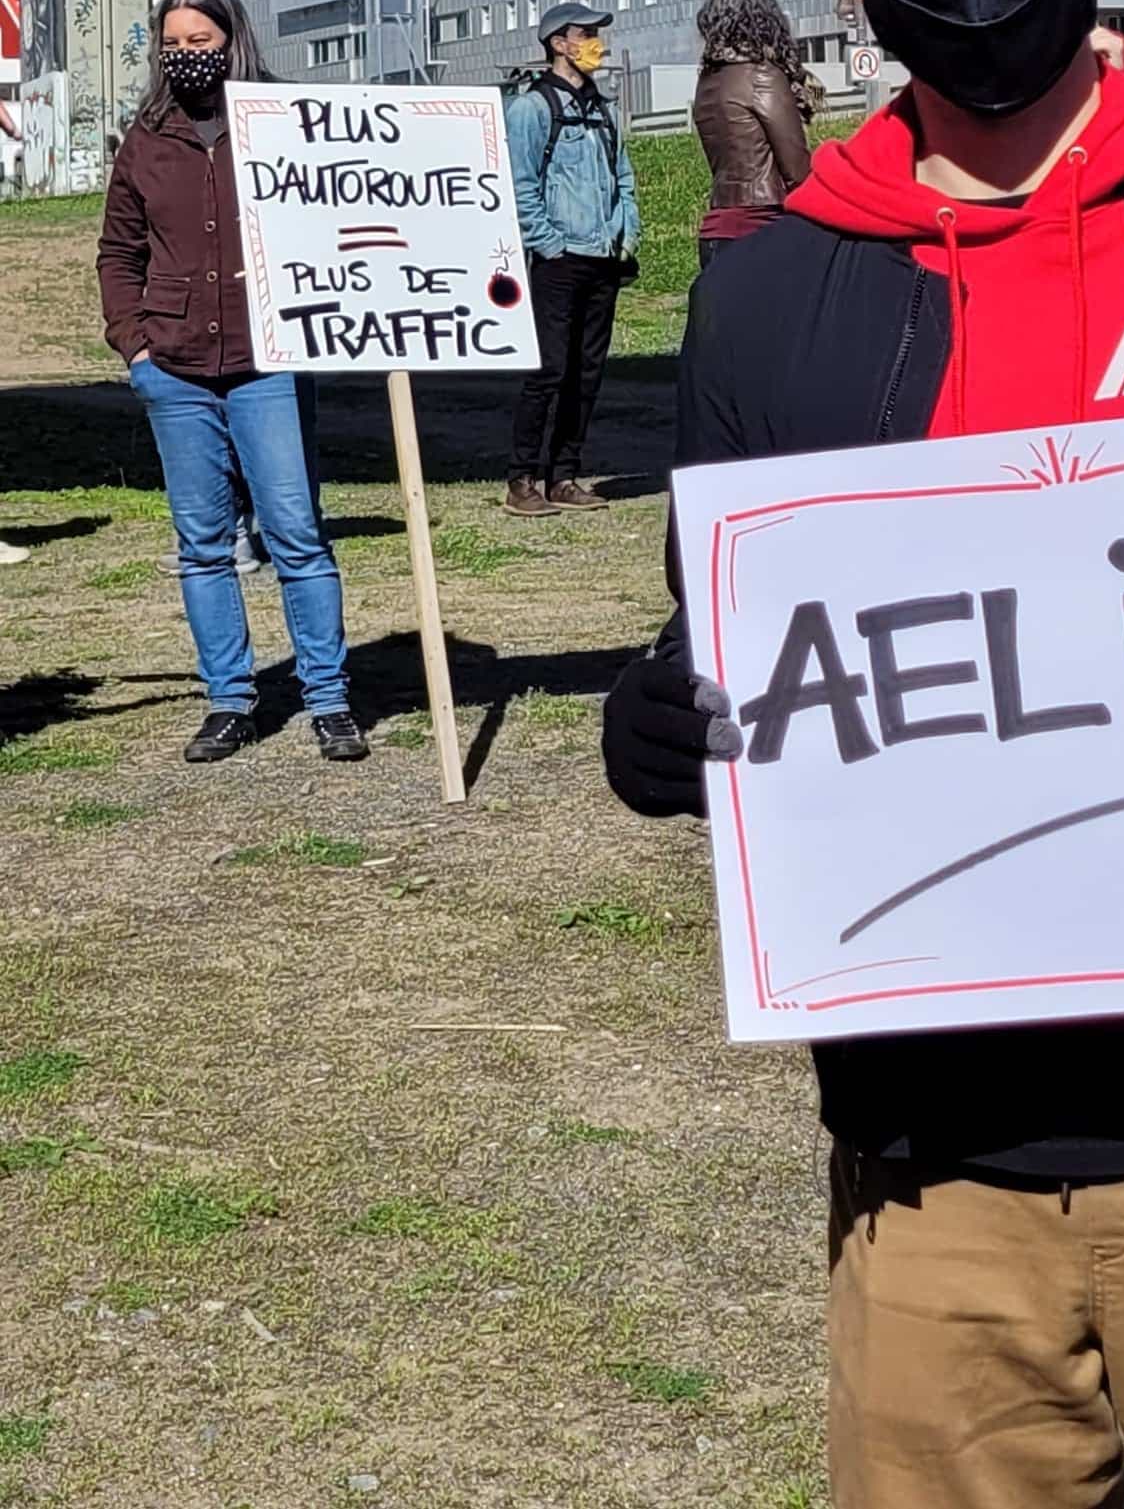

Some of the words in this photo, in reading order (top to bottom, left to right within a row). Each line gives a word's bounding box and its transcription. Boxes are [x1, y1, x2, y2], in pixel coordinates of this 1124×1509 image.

[289, 98, 401, 143] PLUS
[244, 156, 501, 212] D'AUTOROUTES
[281, 260, 372, 294] PLUS
[399, 264, 468, 294] DE
